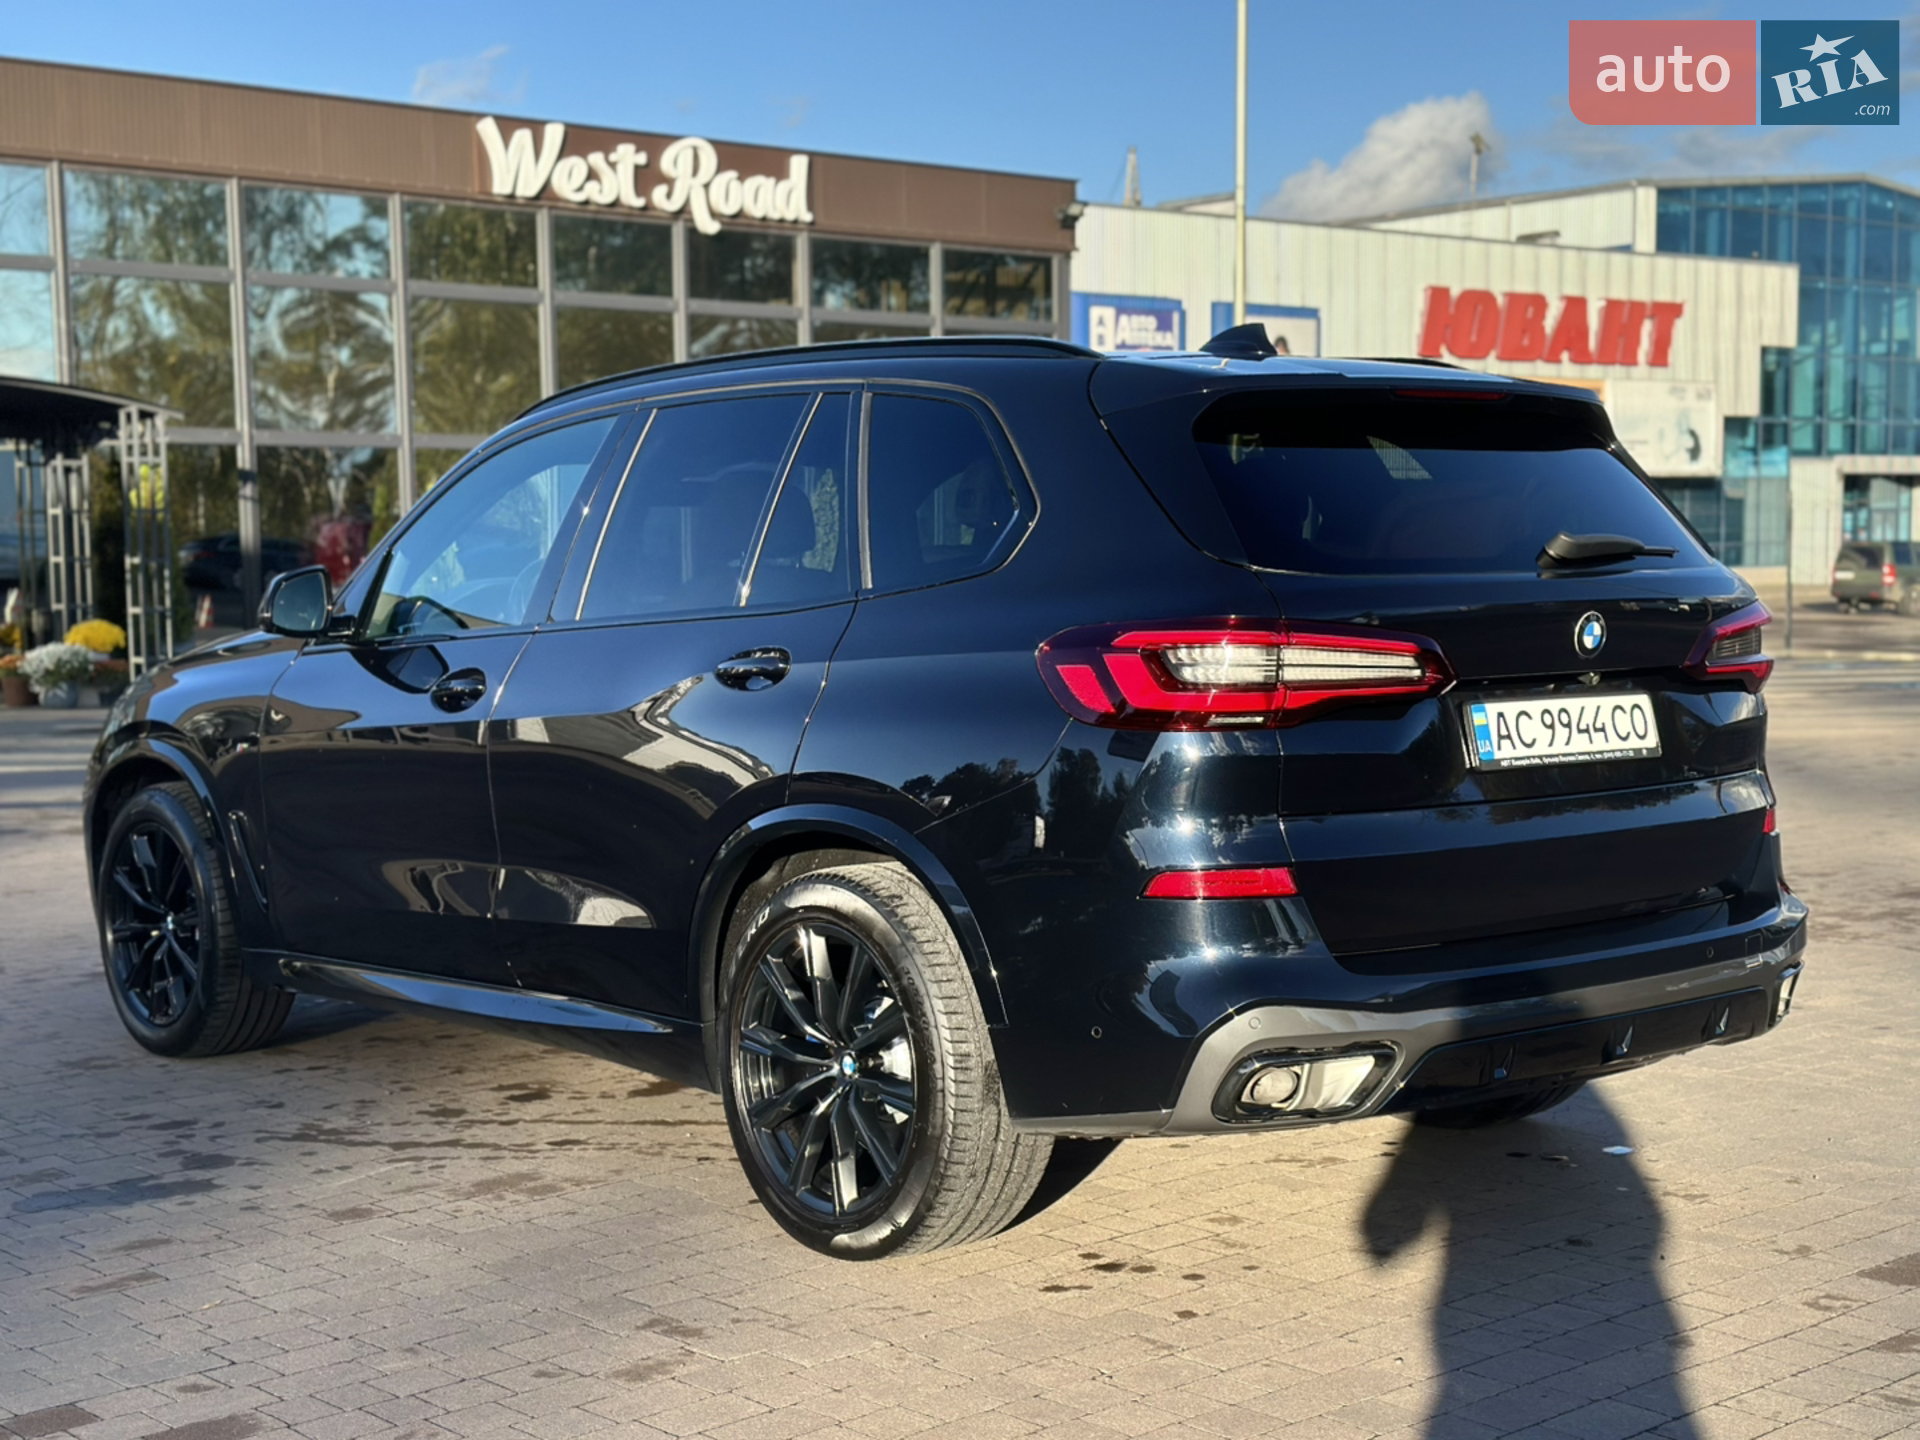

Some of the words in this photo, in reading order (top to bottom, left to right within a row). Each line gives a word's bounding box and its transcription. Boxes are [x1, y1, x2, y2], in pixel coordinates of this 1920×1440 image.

[476, 116, 648, 208] West
[652, 137, 814, 235] Road
[1418, 286, 1685, 367] ЮВАНТ
[1477, 739, 1493, 753] UA
[1497, 710, 1537, 751] AC
[1540, 705, 1610, 748] 9944
